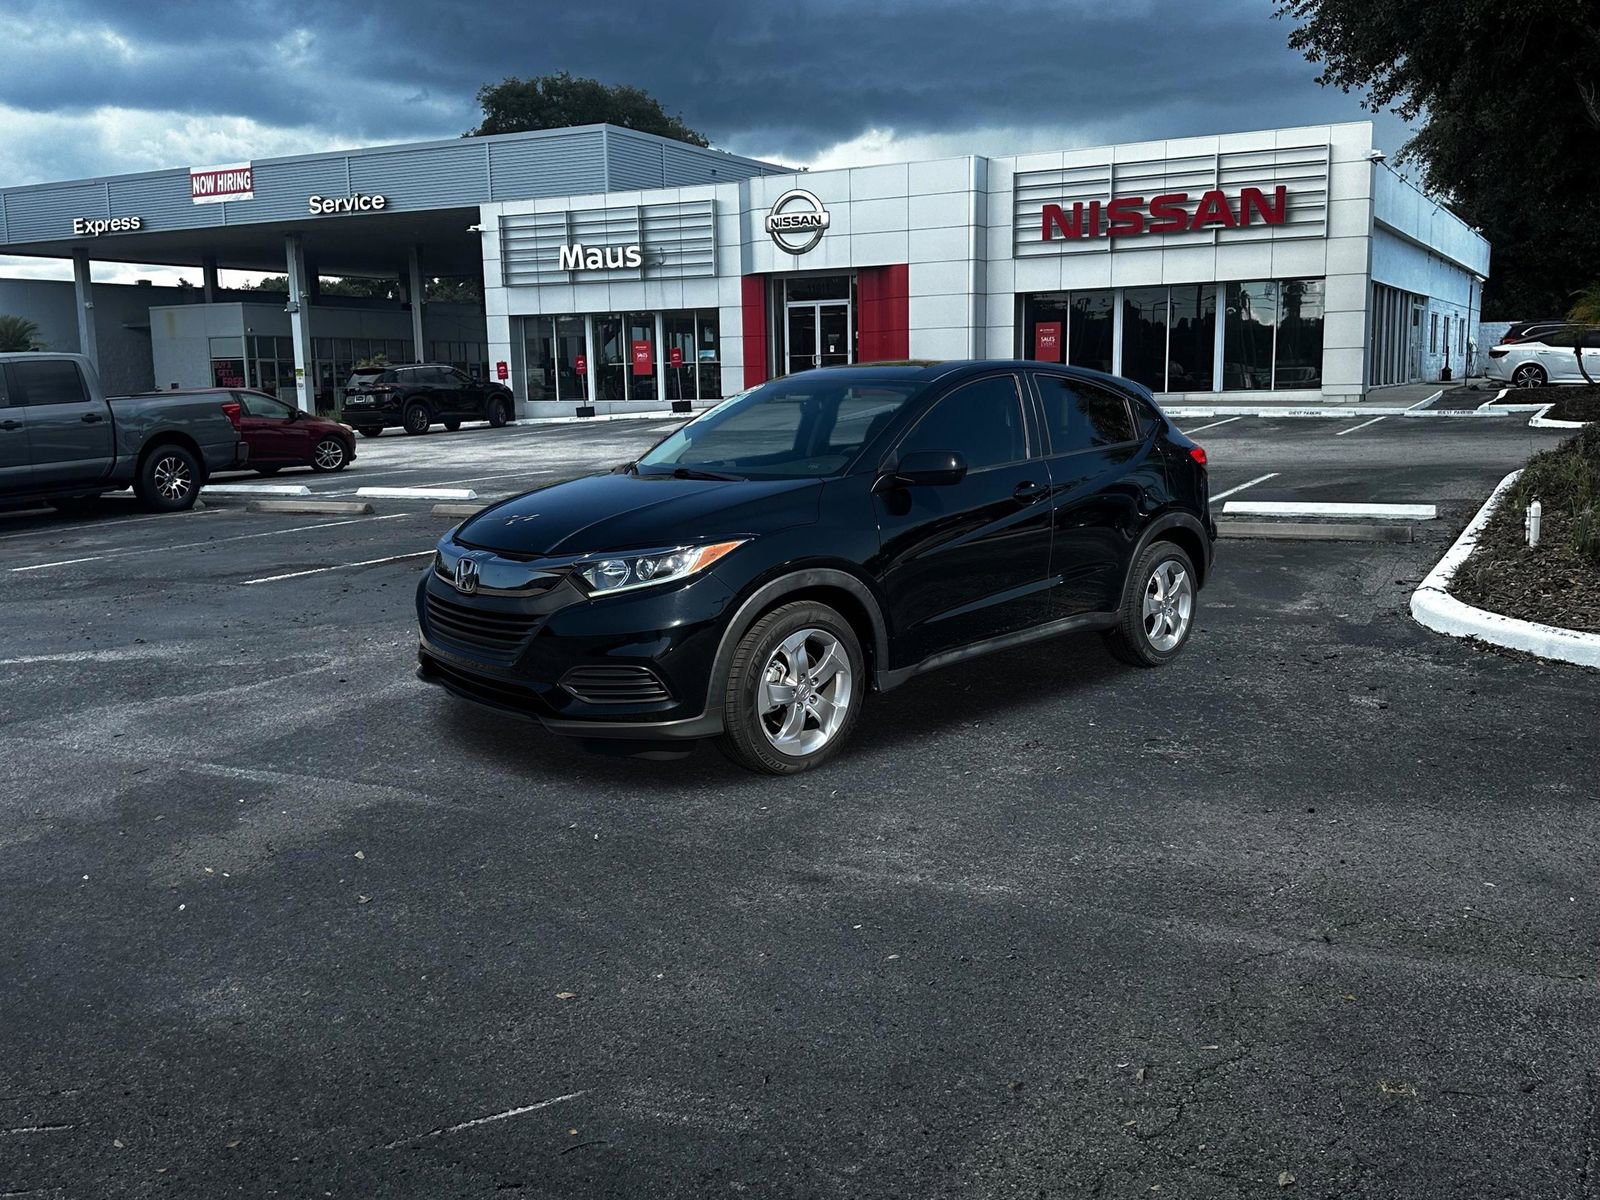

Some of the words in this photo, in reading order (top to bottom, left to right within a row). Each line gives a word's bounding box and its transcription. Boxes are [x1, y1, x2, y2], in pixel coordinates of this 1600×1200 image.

[192, 174, 215, 195] NOW
[217, 171, 251, 192] HIRING
[309, 192, 385, 215] Service
[1042, 185, 1287, 241] NISSAN
[73, 216, 141, 237] Express
[770, 214, 822, 228] NISSAN
[559, 243, 642, 271] Maus
[223, 377, 244, 386] FREE
